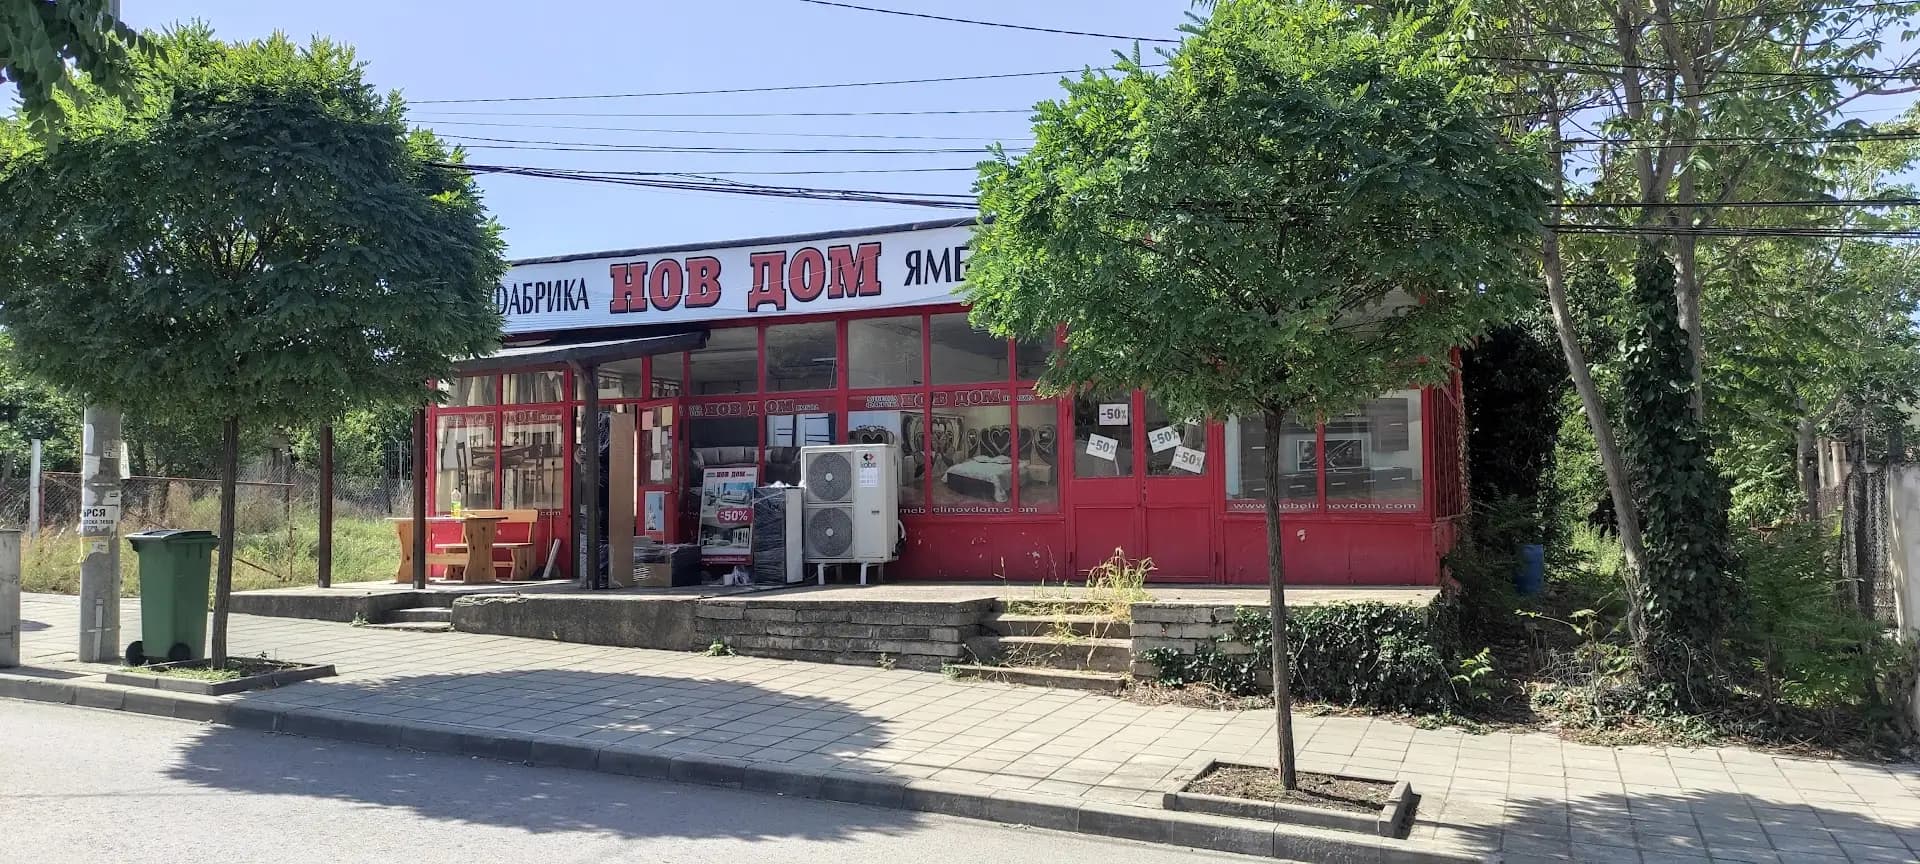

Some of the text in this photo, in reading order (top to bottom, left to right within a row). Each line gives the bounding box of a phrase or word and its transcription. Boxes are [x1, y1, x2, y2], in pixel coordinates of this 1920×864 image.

[609, 255, 722, 314] НОВ
[747, 242, 882, 313] ДОМ
[954, 389, 1001, 407] ДОМ
[705, 402, 741, 417] НОВ
[1100, 408, 1127, 420] -50%
[1150, 430, 1179, 445] -50%
[1090, 440, 1116, 455] -50%
[1175, 451, 1203, 468] -50%
